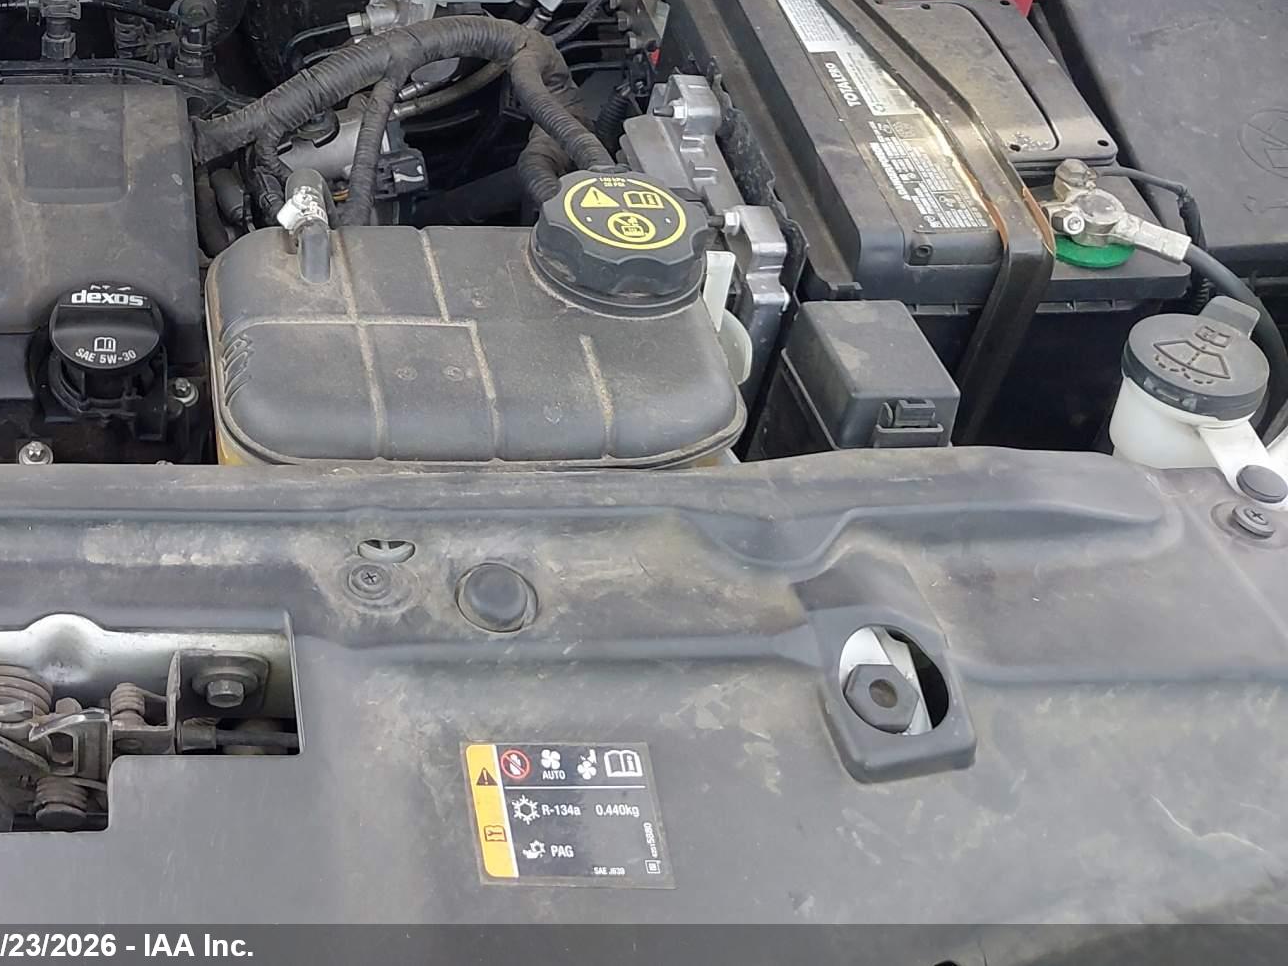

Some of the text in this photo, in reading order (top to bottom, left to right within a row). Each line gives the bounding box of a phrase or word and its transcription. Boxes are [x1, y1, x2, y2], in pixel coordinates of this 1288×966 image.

[71, 290, 145, 307] dexos
[75, 347, 137, 365] SAE 5W-30
[542, 769, 566, 781] AUTO
[541, 804, 640, 818] R-134a 0.440kg
[550, 845, 575, 858] PAG
